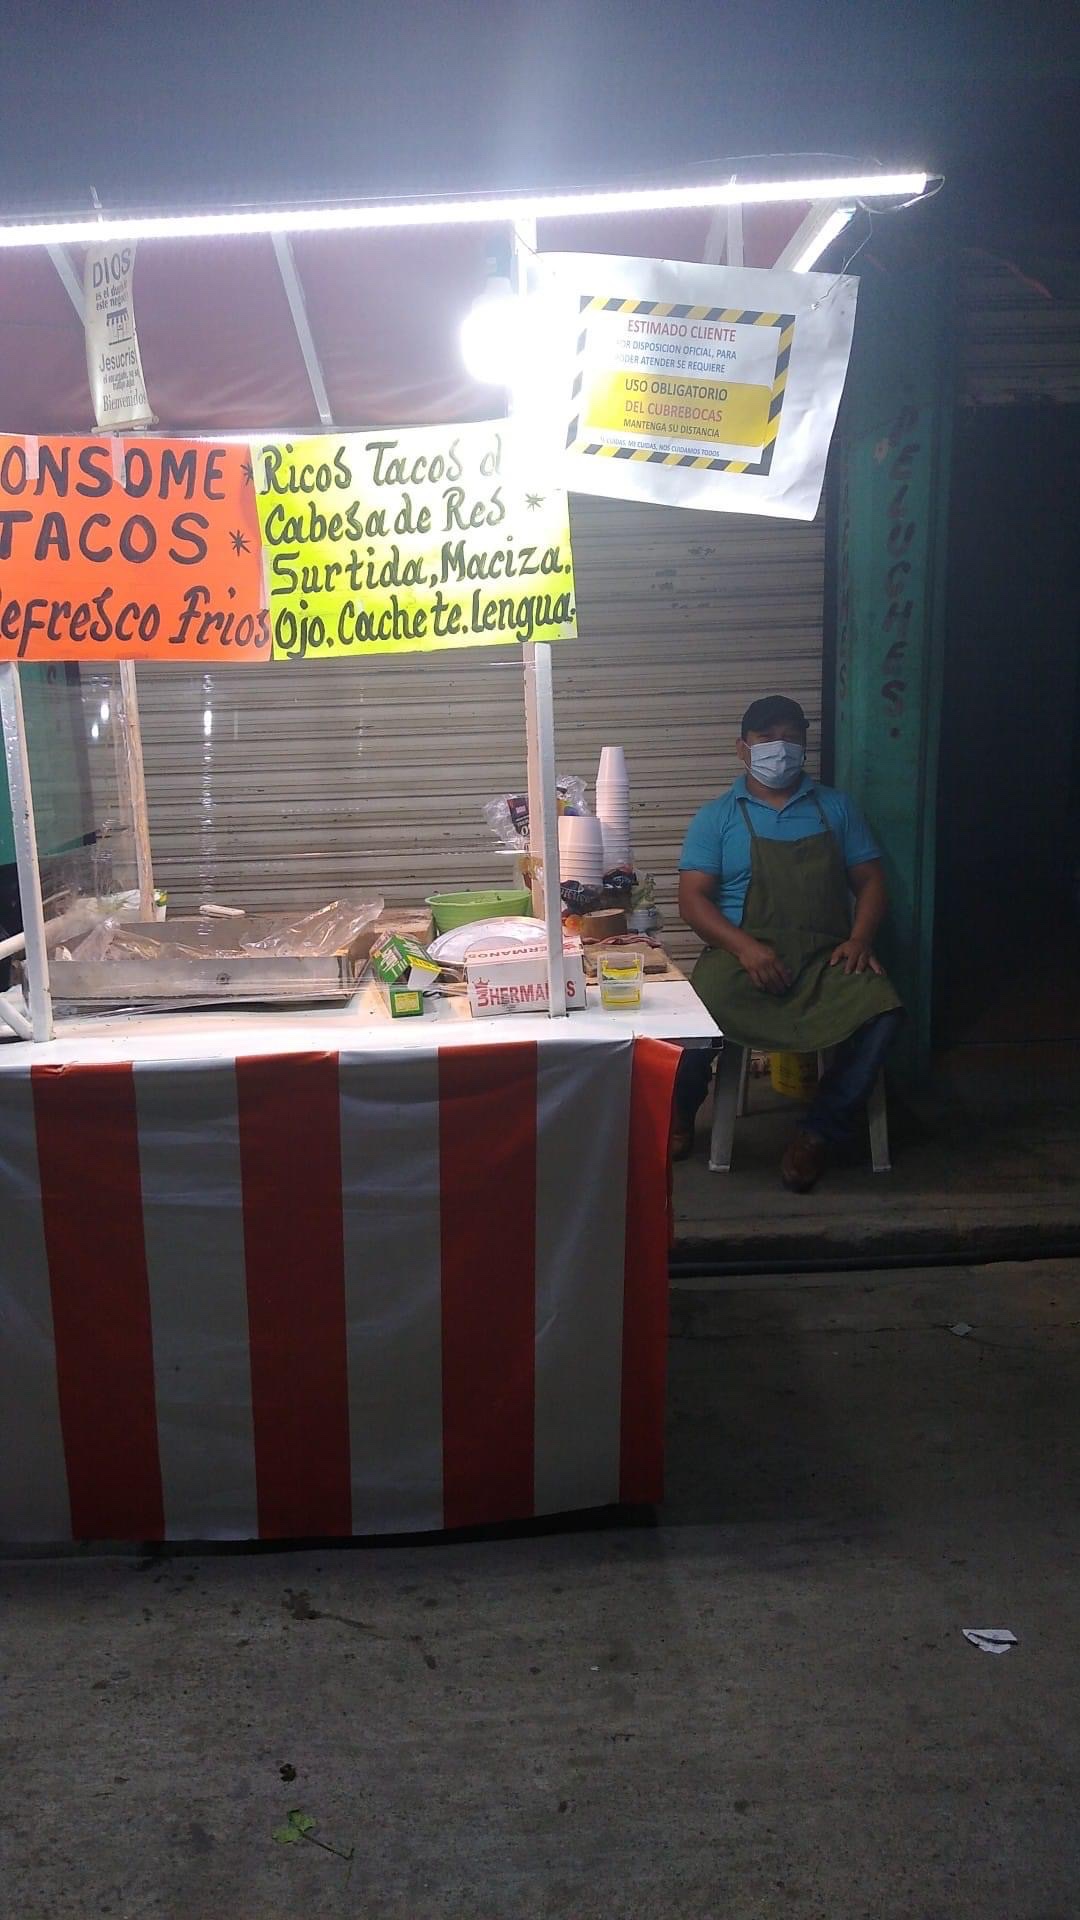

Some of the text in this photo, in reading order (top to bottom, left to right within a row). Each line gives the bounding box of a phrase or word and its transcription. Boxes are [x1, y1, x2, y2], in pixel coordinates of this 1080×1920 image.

[93, 247, 131, 288] DIOS
[627, 319, 737, 342] ESTIMADO CLIENTE
[632, 340, 682, 354] DISPOSICION
[683, 345, 714, 358] OFICIAL,
[716, 349, 737, 360] PARA
[640, 355, 675, 368] ATENDER
[676, 359, 686, 369] SE
[687, 361, 726, 373] REQUIERE
[625, 378, 728, 401] USO OBLIGATORIO
[625, 400, 723, 422] DEL CUBREBOCAS
[623, 418, 720, 438] MANTENGA SU DISTANCIA
[260, 443, 352, 494] Ricos
[365, 438, 462, 487] Tacos
[441, 486, 506, 531] Res
[0, 510, 209, 565] TACOS
[468, 945, 547, 959] ERMANOS
